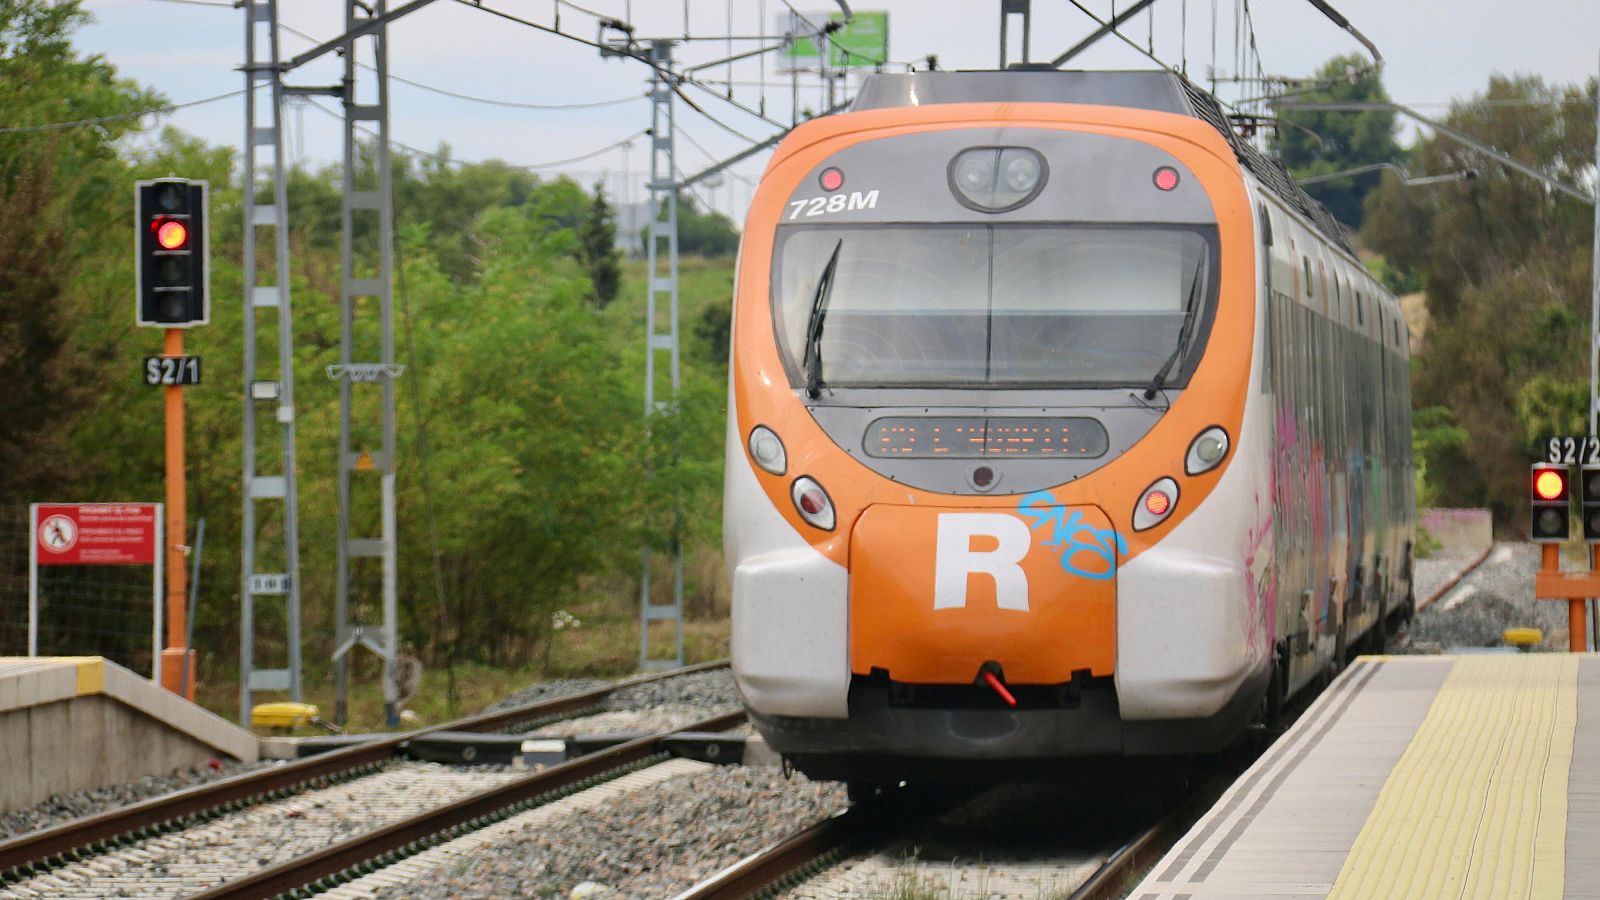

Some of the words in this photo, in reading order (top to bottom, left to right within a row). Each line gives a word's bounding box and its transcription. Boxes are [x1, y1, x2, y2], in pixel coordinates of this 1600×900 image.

[789, 189, 879, 220] 728M
[147, 356, 198, 385] S2/1
[1549, 436, 1600, 465] S2/2
[934, 512, 1031, 612] R
